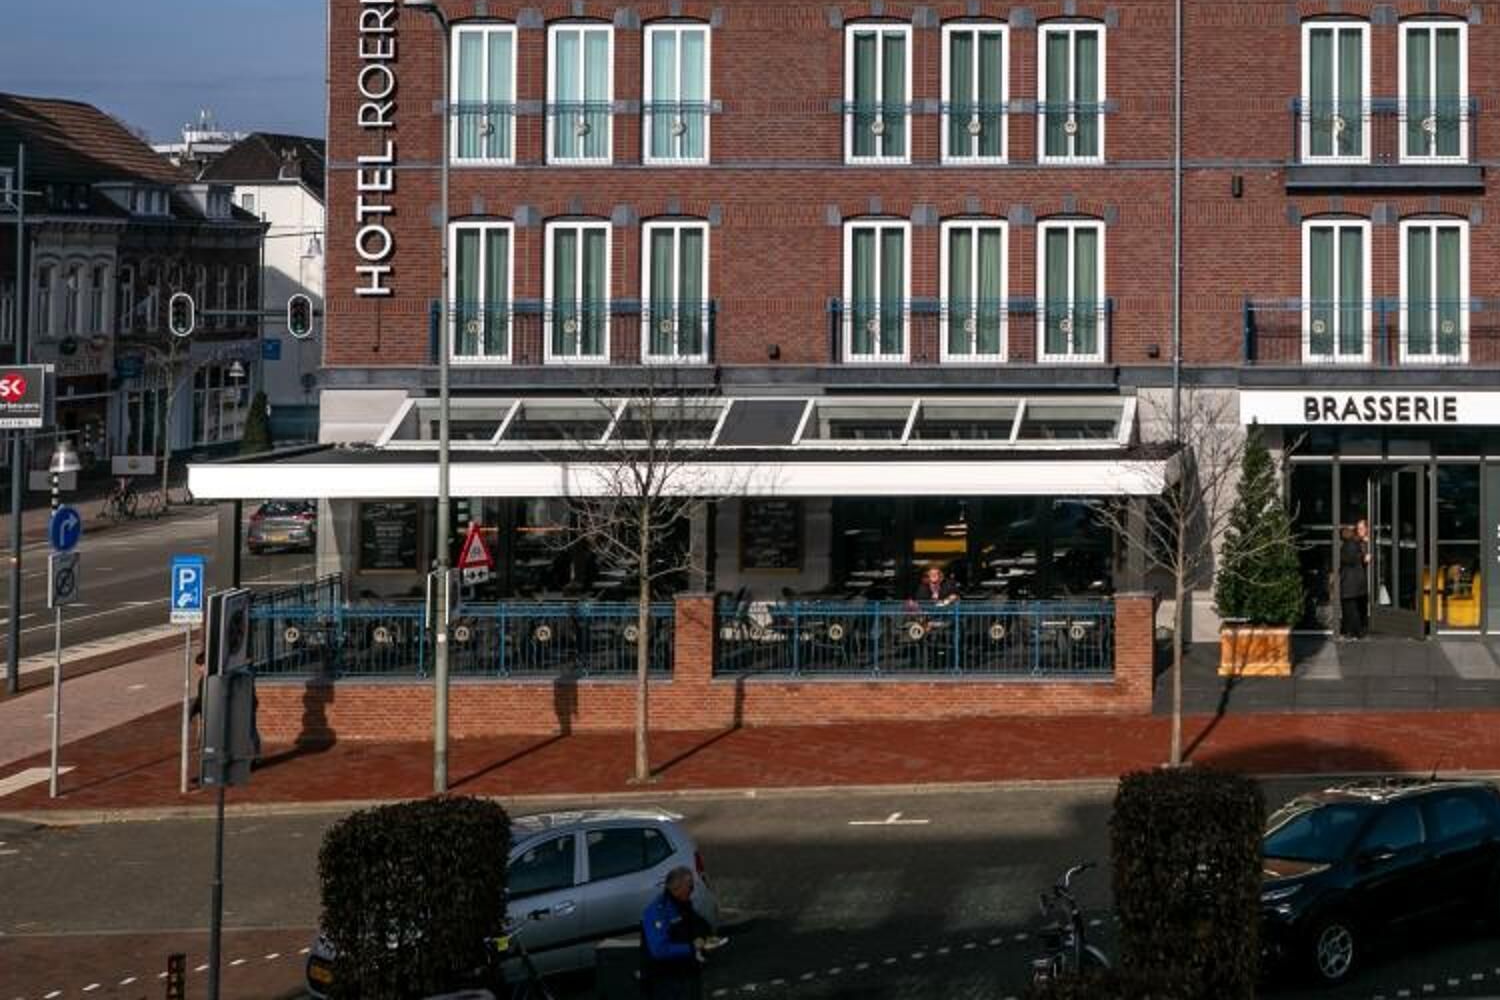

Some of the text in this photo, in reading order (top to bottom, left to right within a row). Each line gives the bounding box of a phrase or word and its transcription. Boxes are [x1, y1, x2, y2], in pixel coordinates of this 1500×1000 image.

[355, 140, 393, 295] HOTEL
[1304, 395, 1457, 423] BRASSERIE
[179, 568, 197, 591] P
